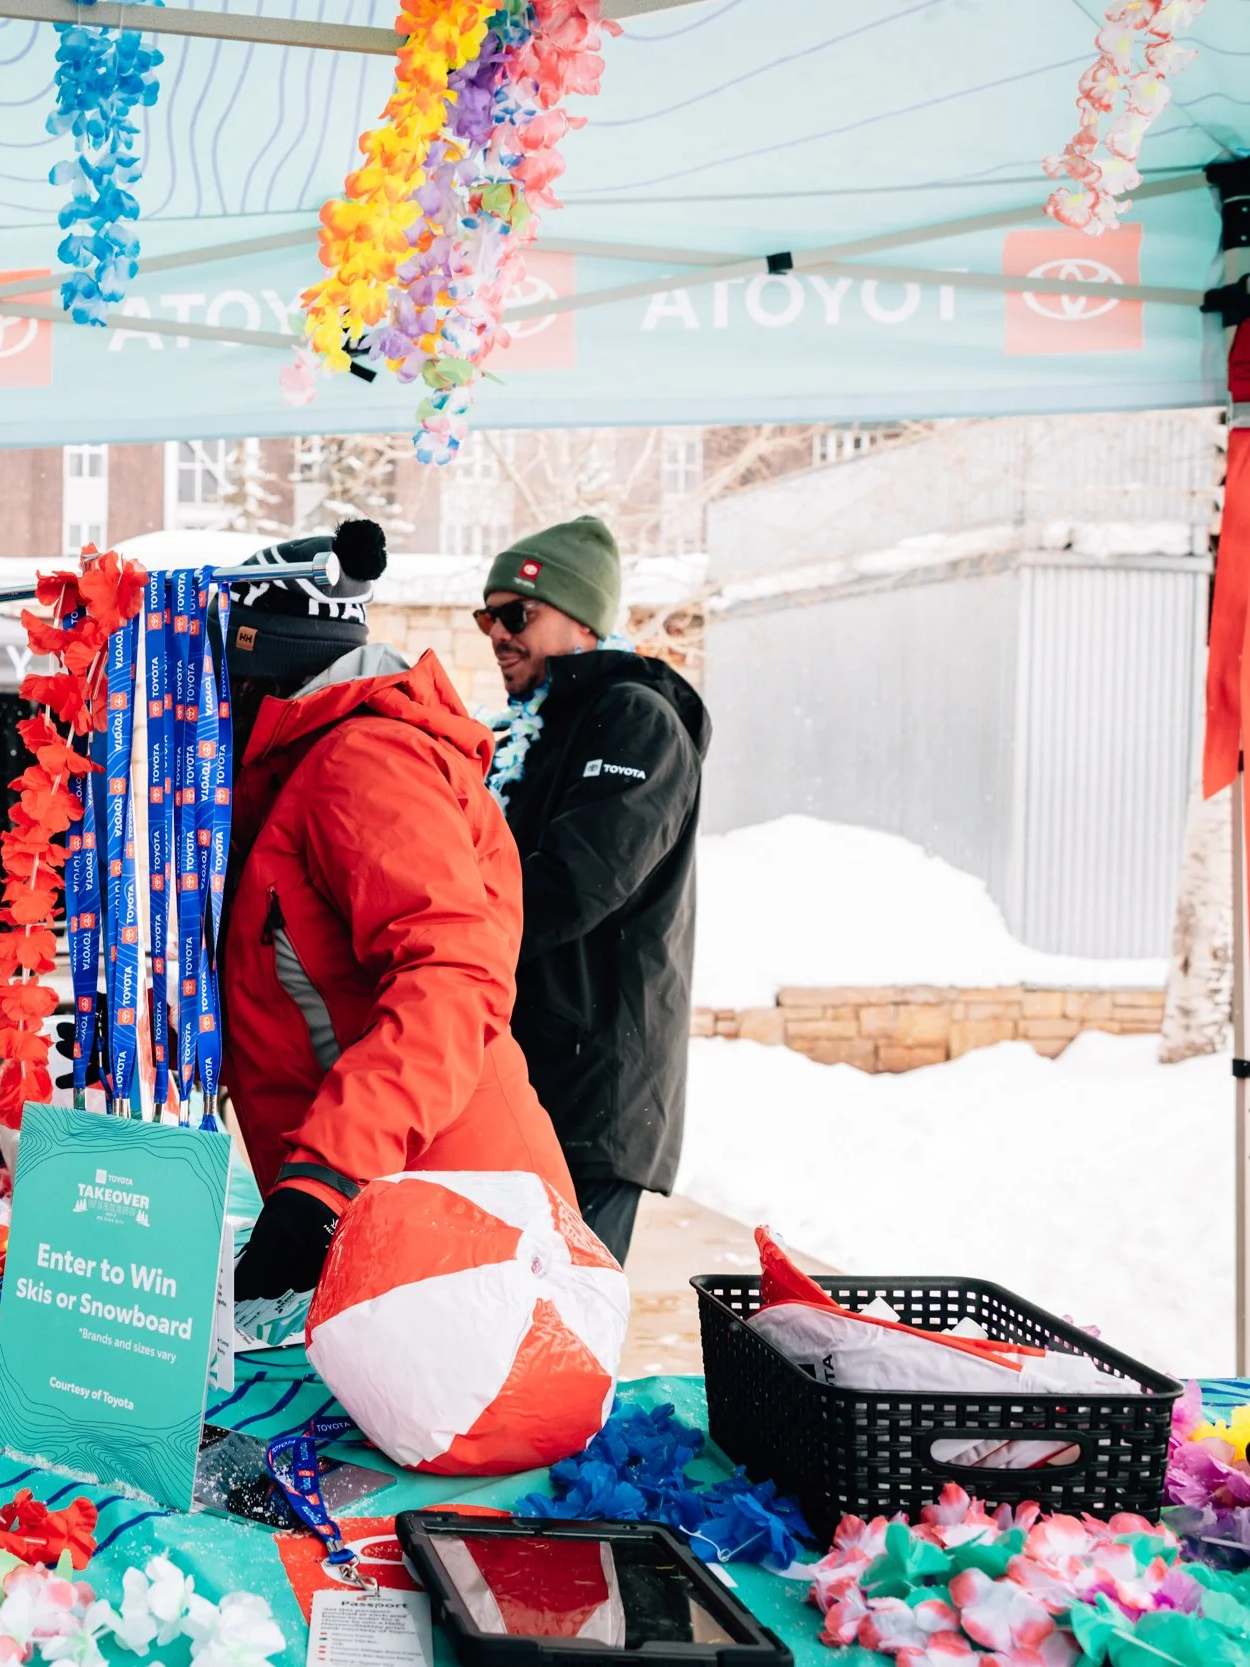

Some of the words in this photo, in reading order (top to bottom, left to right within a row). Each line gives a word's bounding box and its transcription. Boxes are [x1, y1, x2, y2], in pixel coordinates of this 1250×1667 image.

[150, 570, 159, 610] TOYOTA
[177, 571, 187, 612] TOYOTA
[115, 629, 124, 669] TOYOTA
[239, 632, 253, 643] HH
[151, 656, 159, 698] TOYOTA
[187, 663, 195, 702] TOYOTA
[205, 676, 213, 716] TOYOTA
[115, 712, 123, 752] TOYOTA
[152, 743, 160, 783] TOYOTA
[186, 745, 195, 785] TOYOTA
[201, 761, 211, 802] TOYOTA
[217, 744, 226, 784] TOYOTA
[603, 763, 646, 780] TOYOTA
[114, 797, 123, 837] TOYOTA
[153, 830, 161, 870] TOYOTA
[186, 831, 195, 871] TOYOTA
[200, 850, 208, 890] TOYOTA
[215, 831, 224, 873] TOYOTA
[85, 852, 93, 891] TOYOTA
[126, 884, 135, 925] TOYOTA
[82, 932, 91, 971] TOYOTA
[154, 914, 162, 954] TOYOTA
[185, 936, 193, 976] TOYOTA
[122, 965, 133, 1006] TOYOTA
[201, 971, 209, 1012] TOYOTA
[184, 1022, 192, 1061] TOYOTA
[77, 1183, 150, 1210] TAKEOVER
[108, 1174, 134, 1186] TOYOTA
[37, 1242, 97, 1278] Enter
[100, 1258, 125, 1285] to
[130, 1263, 177, 1298] Win
[16, 1277, 52, 1305] Skis
[56, 1292, 77, 1310] or
[79, 1293, 193, 1340] Snowboard
[114, 1339, 131, 1350] and
[133, 1342, 155, 1357] sizes
[157, 1350, 177, 1364] vary
[49, 1376, 91, 1400] Courtesy
[91, 1389, 103, 1400] of
[103, 1391, 134, 1410] Toyota
[316, 1421, 350, 1432] TOYOTA
